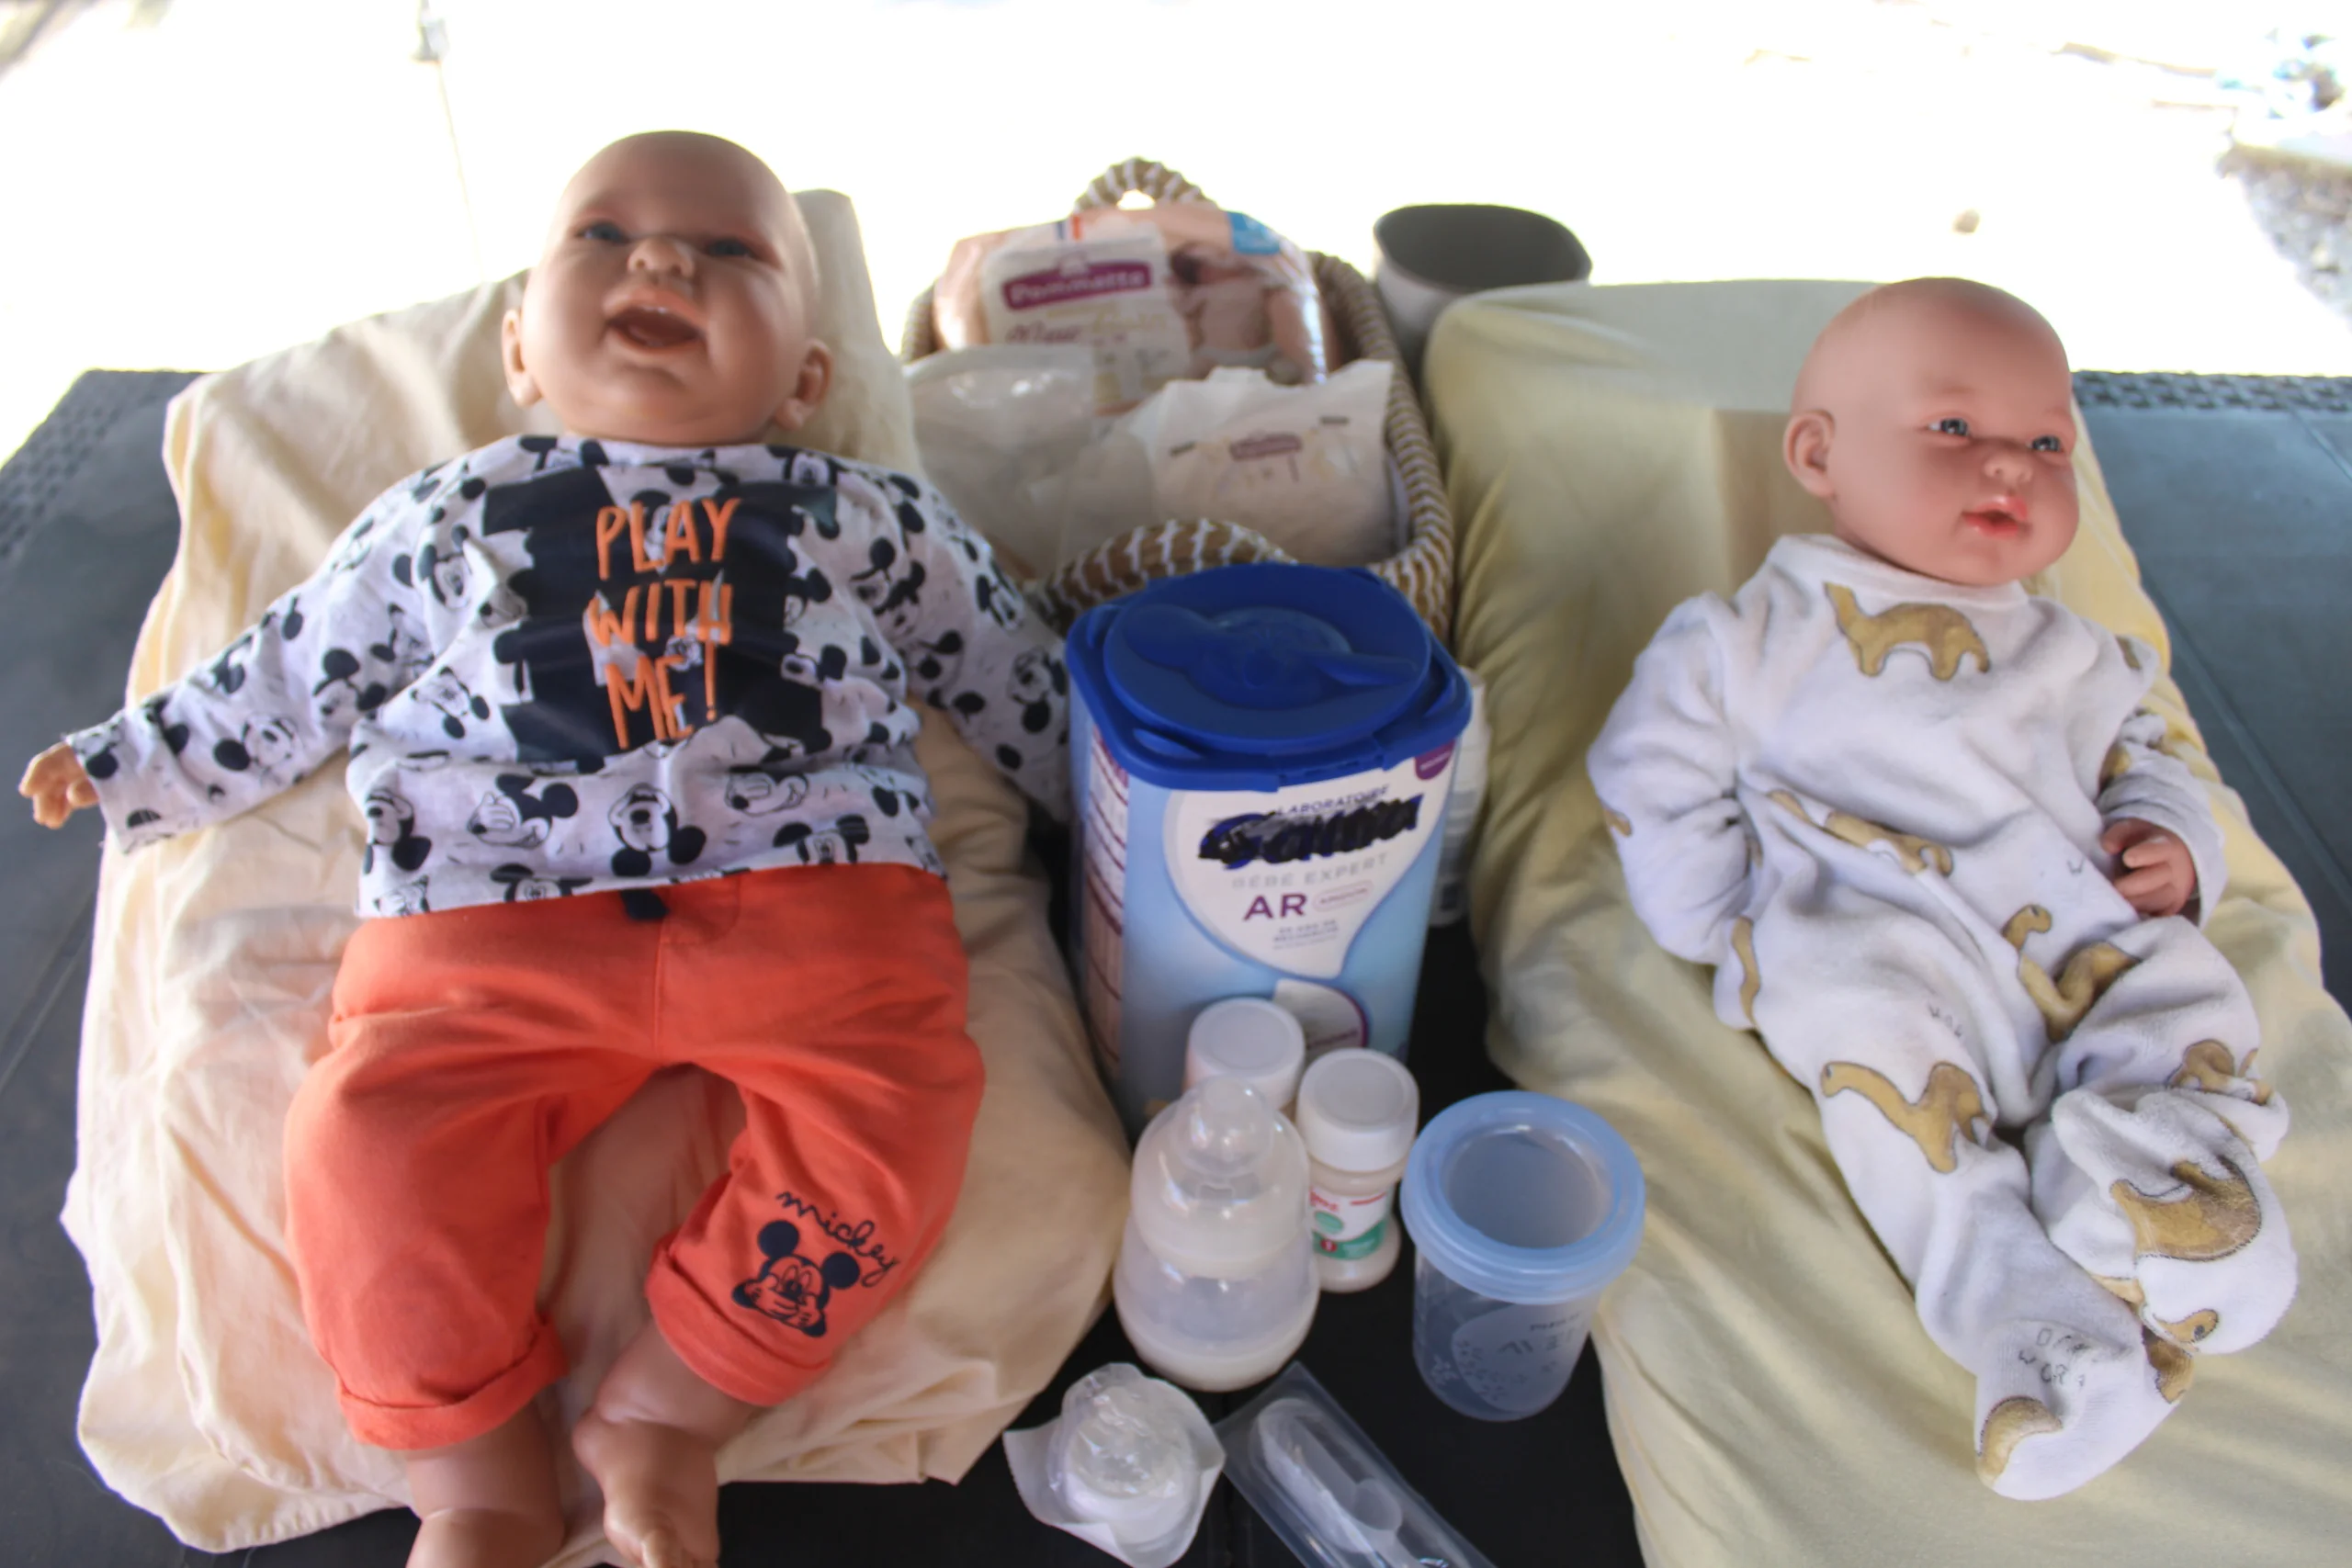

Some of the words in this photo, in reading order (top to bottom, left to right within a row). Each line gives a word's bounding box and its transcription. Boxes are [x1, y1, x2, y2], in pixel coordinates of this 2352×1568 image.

[595, 497, 741, 581] PLAY
[586, 579, 733, 647] WITH
[605, 640, 717, 750] ME!
[1305, 852, 1387, 885] EXPERT
[1243, 893, 1306, 921] AR
